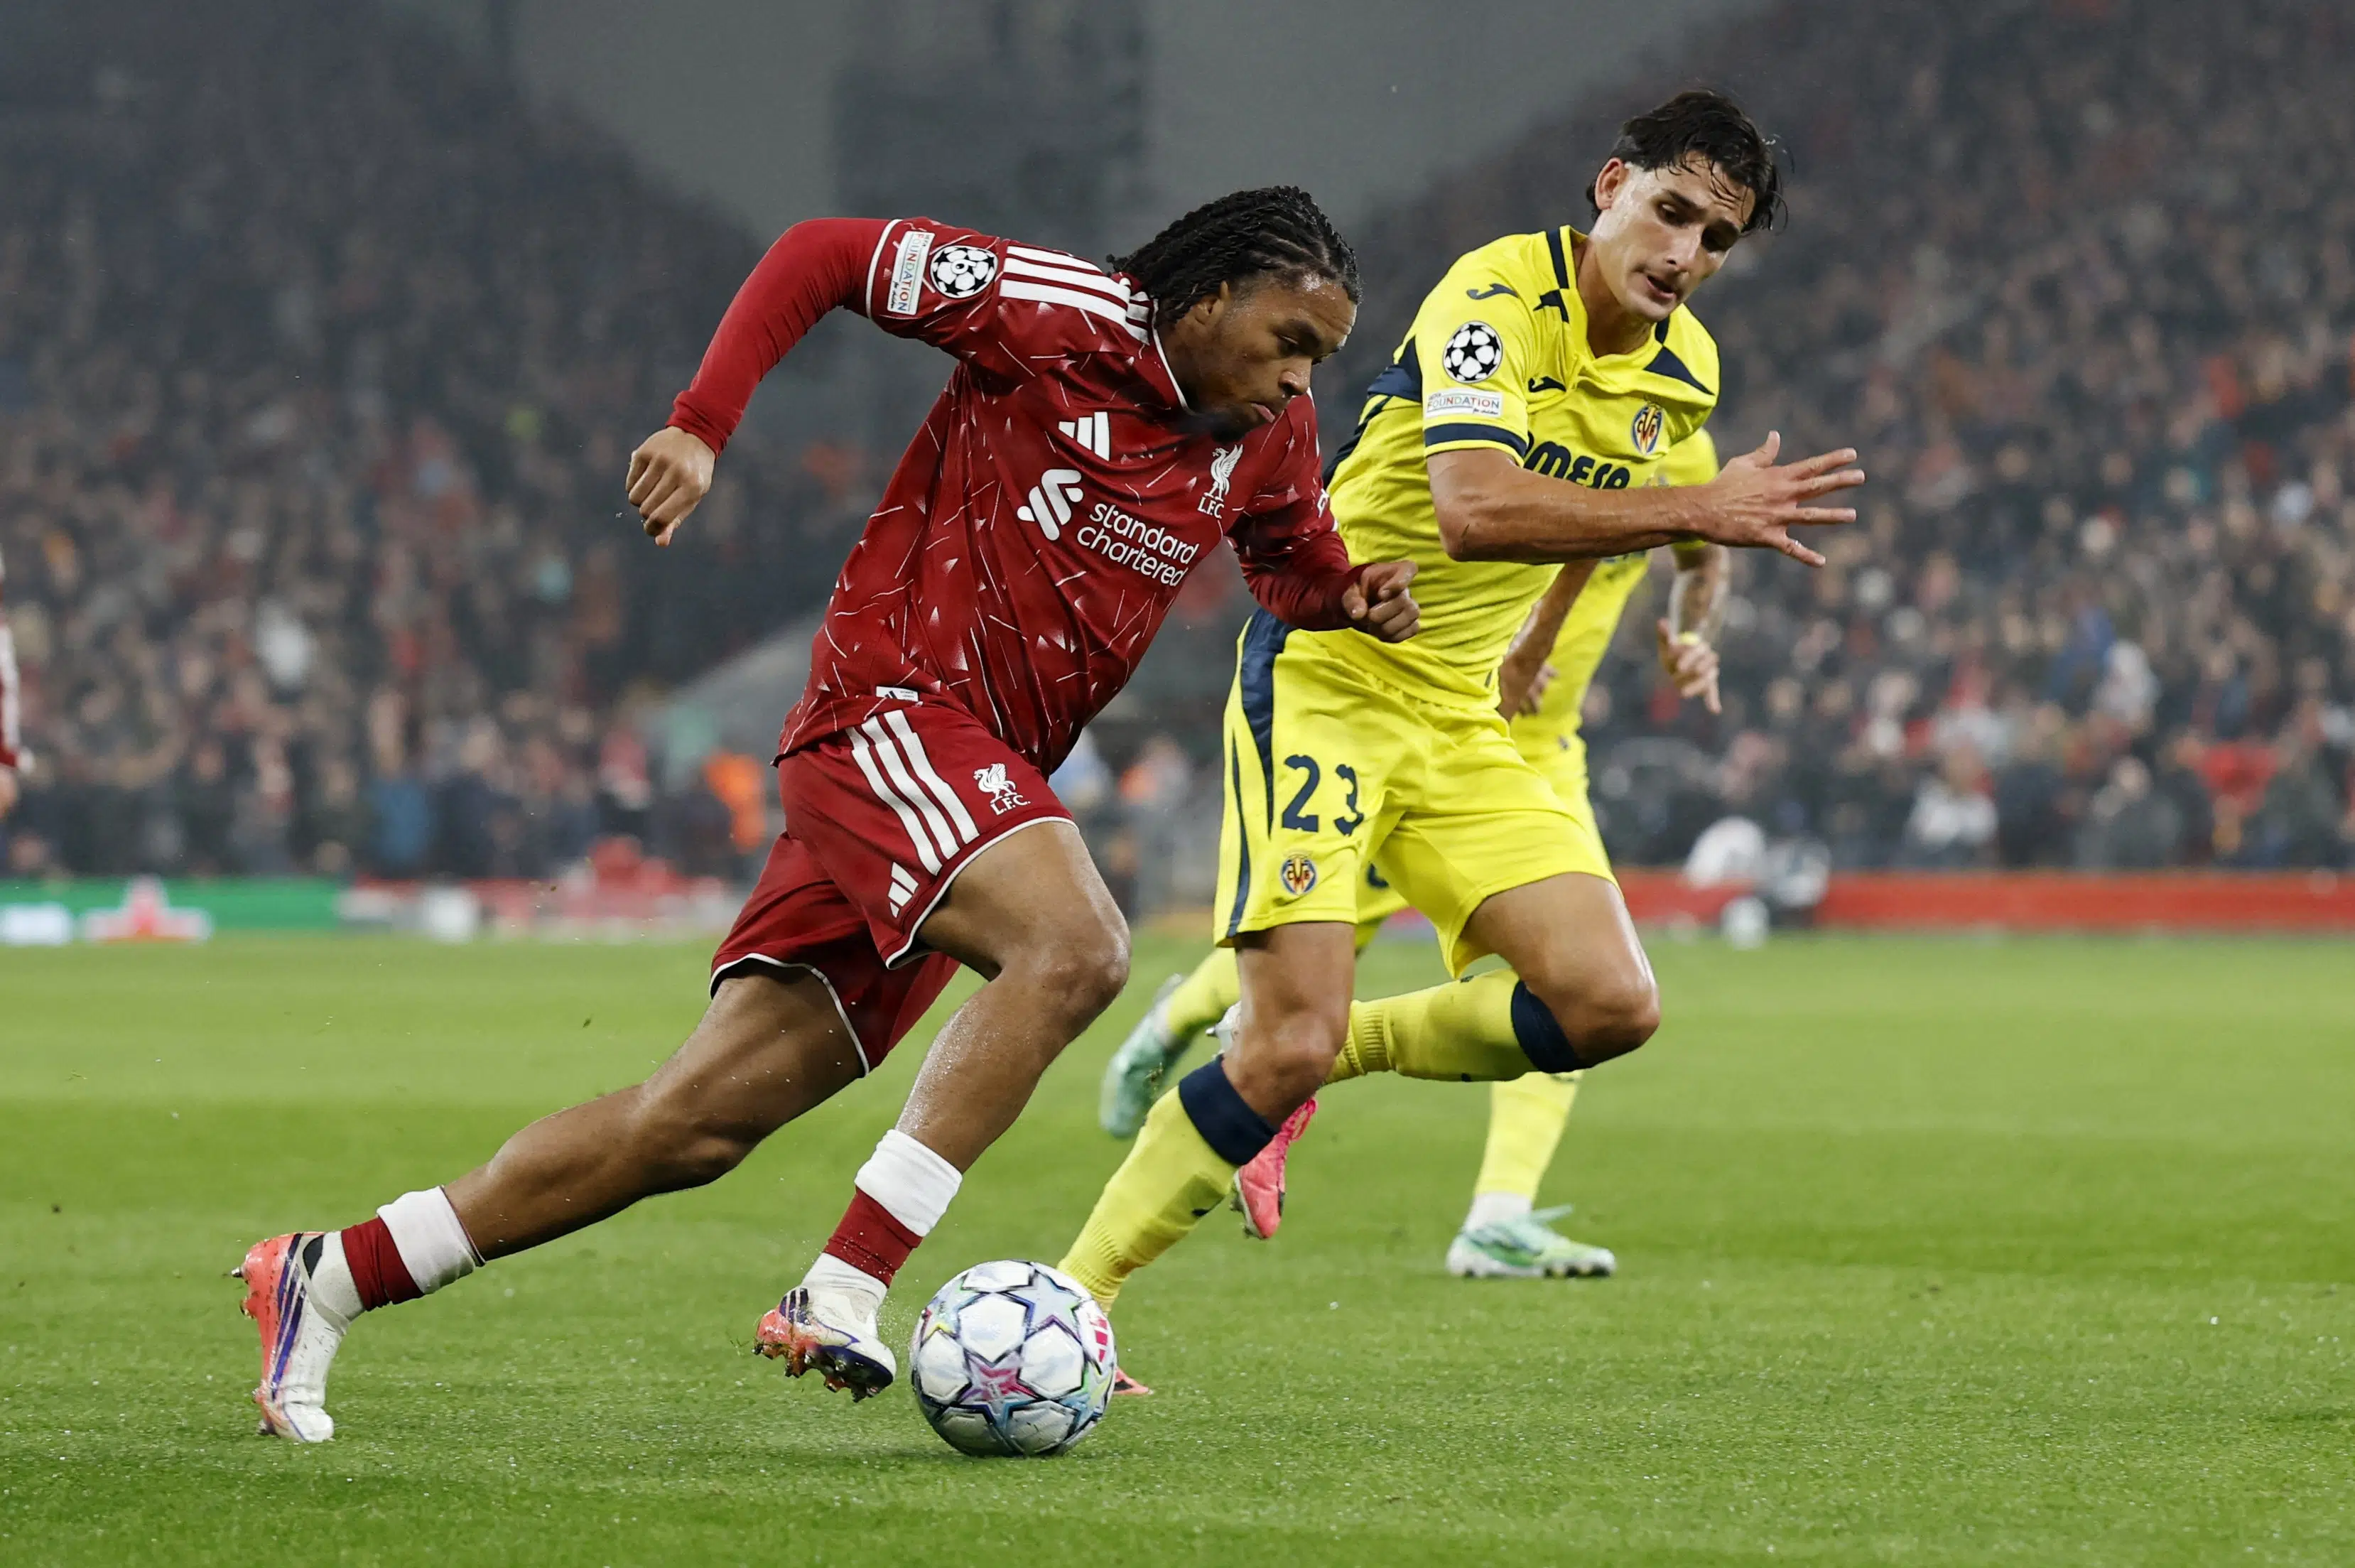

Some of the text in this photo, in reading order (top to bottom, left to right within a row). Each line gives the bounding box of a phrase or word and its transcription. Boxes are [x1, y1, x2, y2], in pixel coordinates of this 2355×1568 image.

[897, 234, 924, 311] FOUNDATION
[1427, 396, 1500, 410] FOUNDATION
[1077, 526, 1187, 587] chartered
[1089, 503, 1200, 565] standard
[990, 795, 1031, 816] L.F.C.
[1281, 754, 1365, 837] 23
